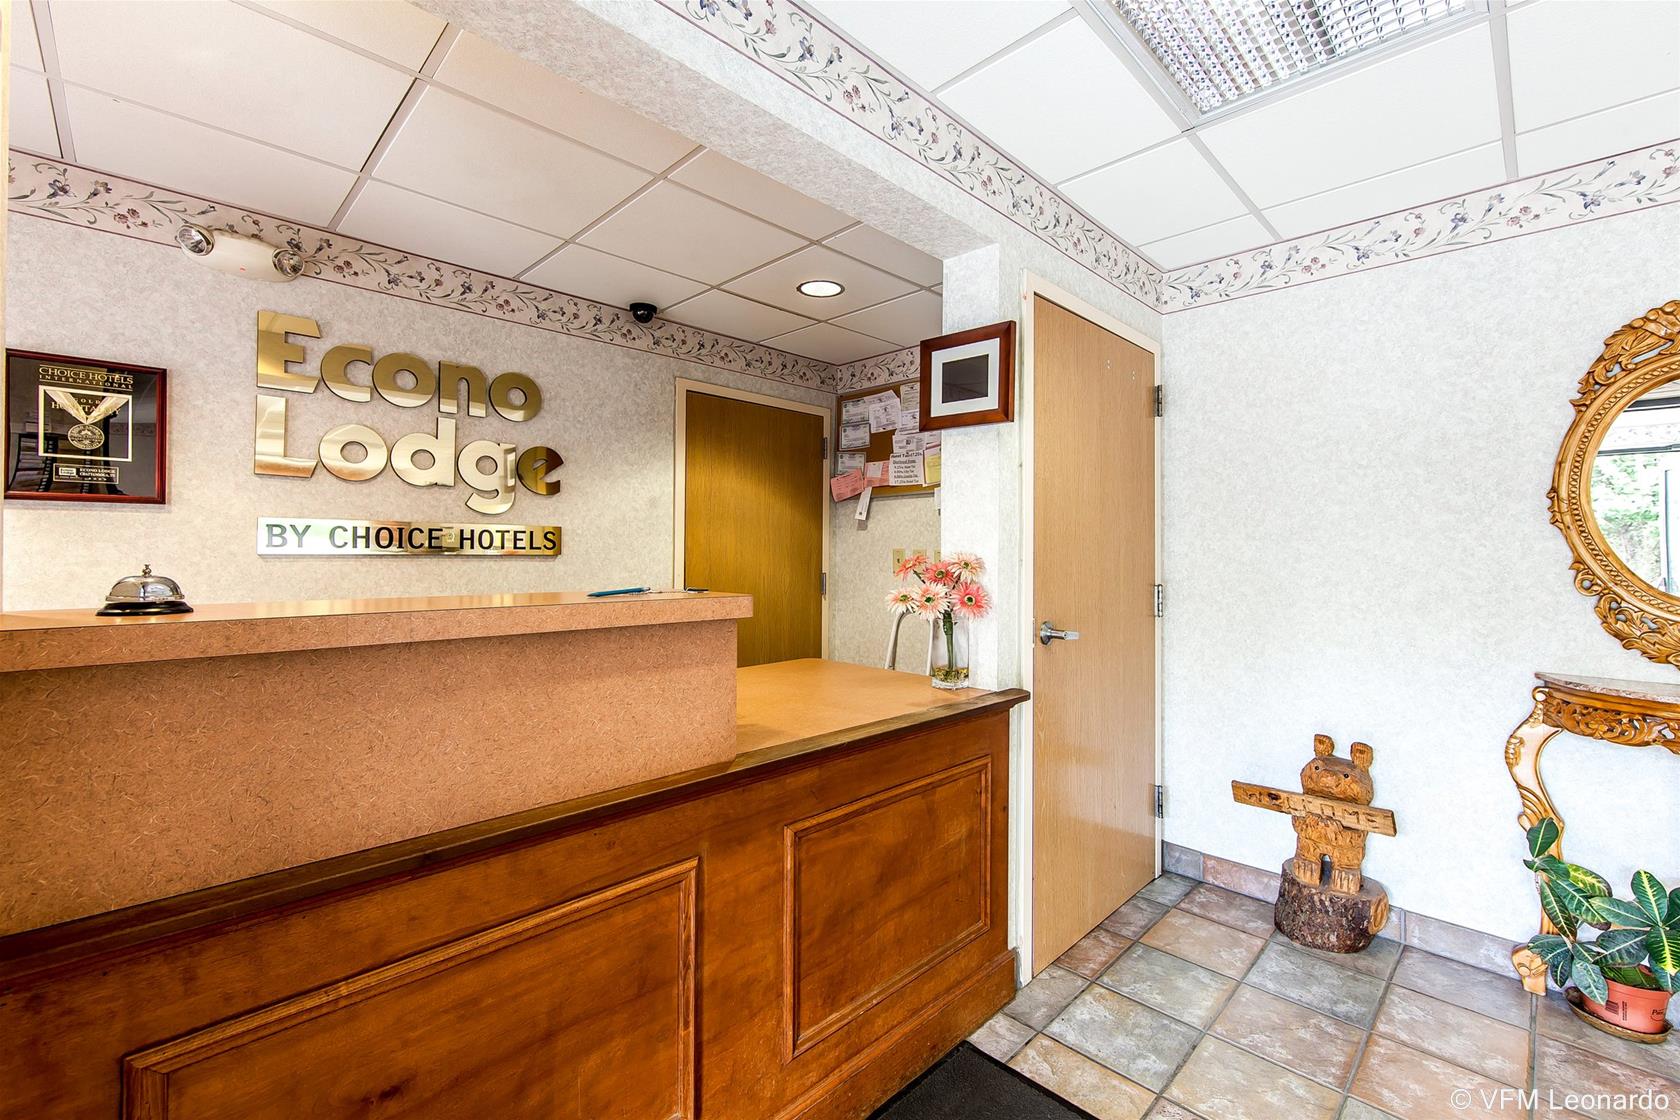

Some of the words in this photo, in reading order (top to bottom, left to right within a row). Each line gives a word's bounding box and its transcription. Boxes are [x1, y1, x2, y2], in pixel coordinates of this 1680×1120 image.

[39, 367, 86, 379] CHOICE
[89, 372, 134, 385] HOTELS
[256, 310, 542, 422] Econo
[39, 375, 133, 389] INTERNATIONAL
[254, 394, 564, 514] Lodge
[265, 523, 312, 548] BY
[328, 525, 443, 550] CHOICE
[459, 529, 557, 550] HOTELS
